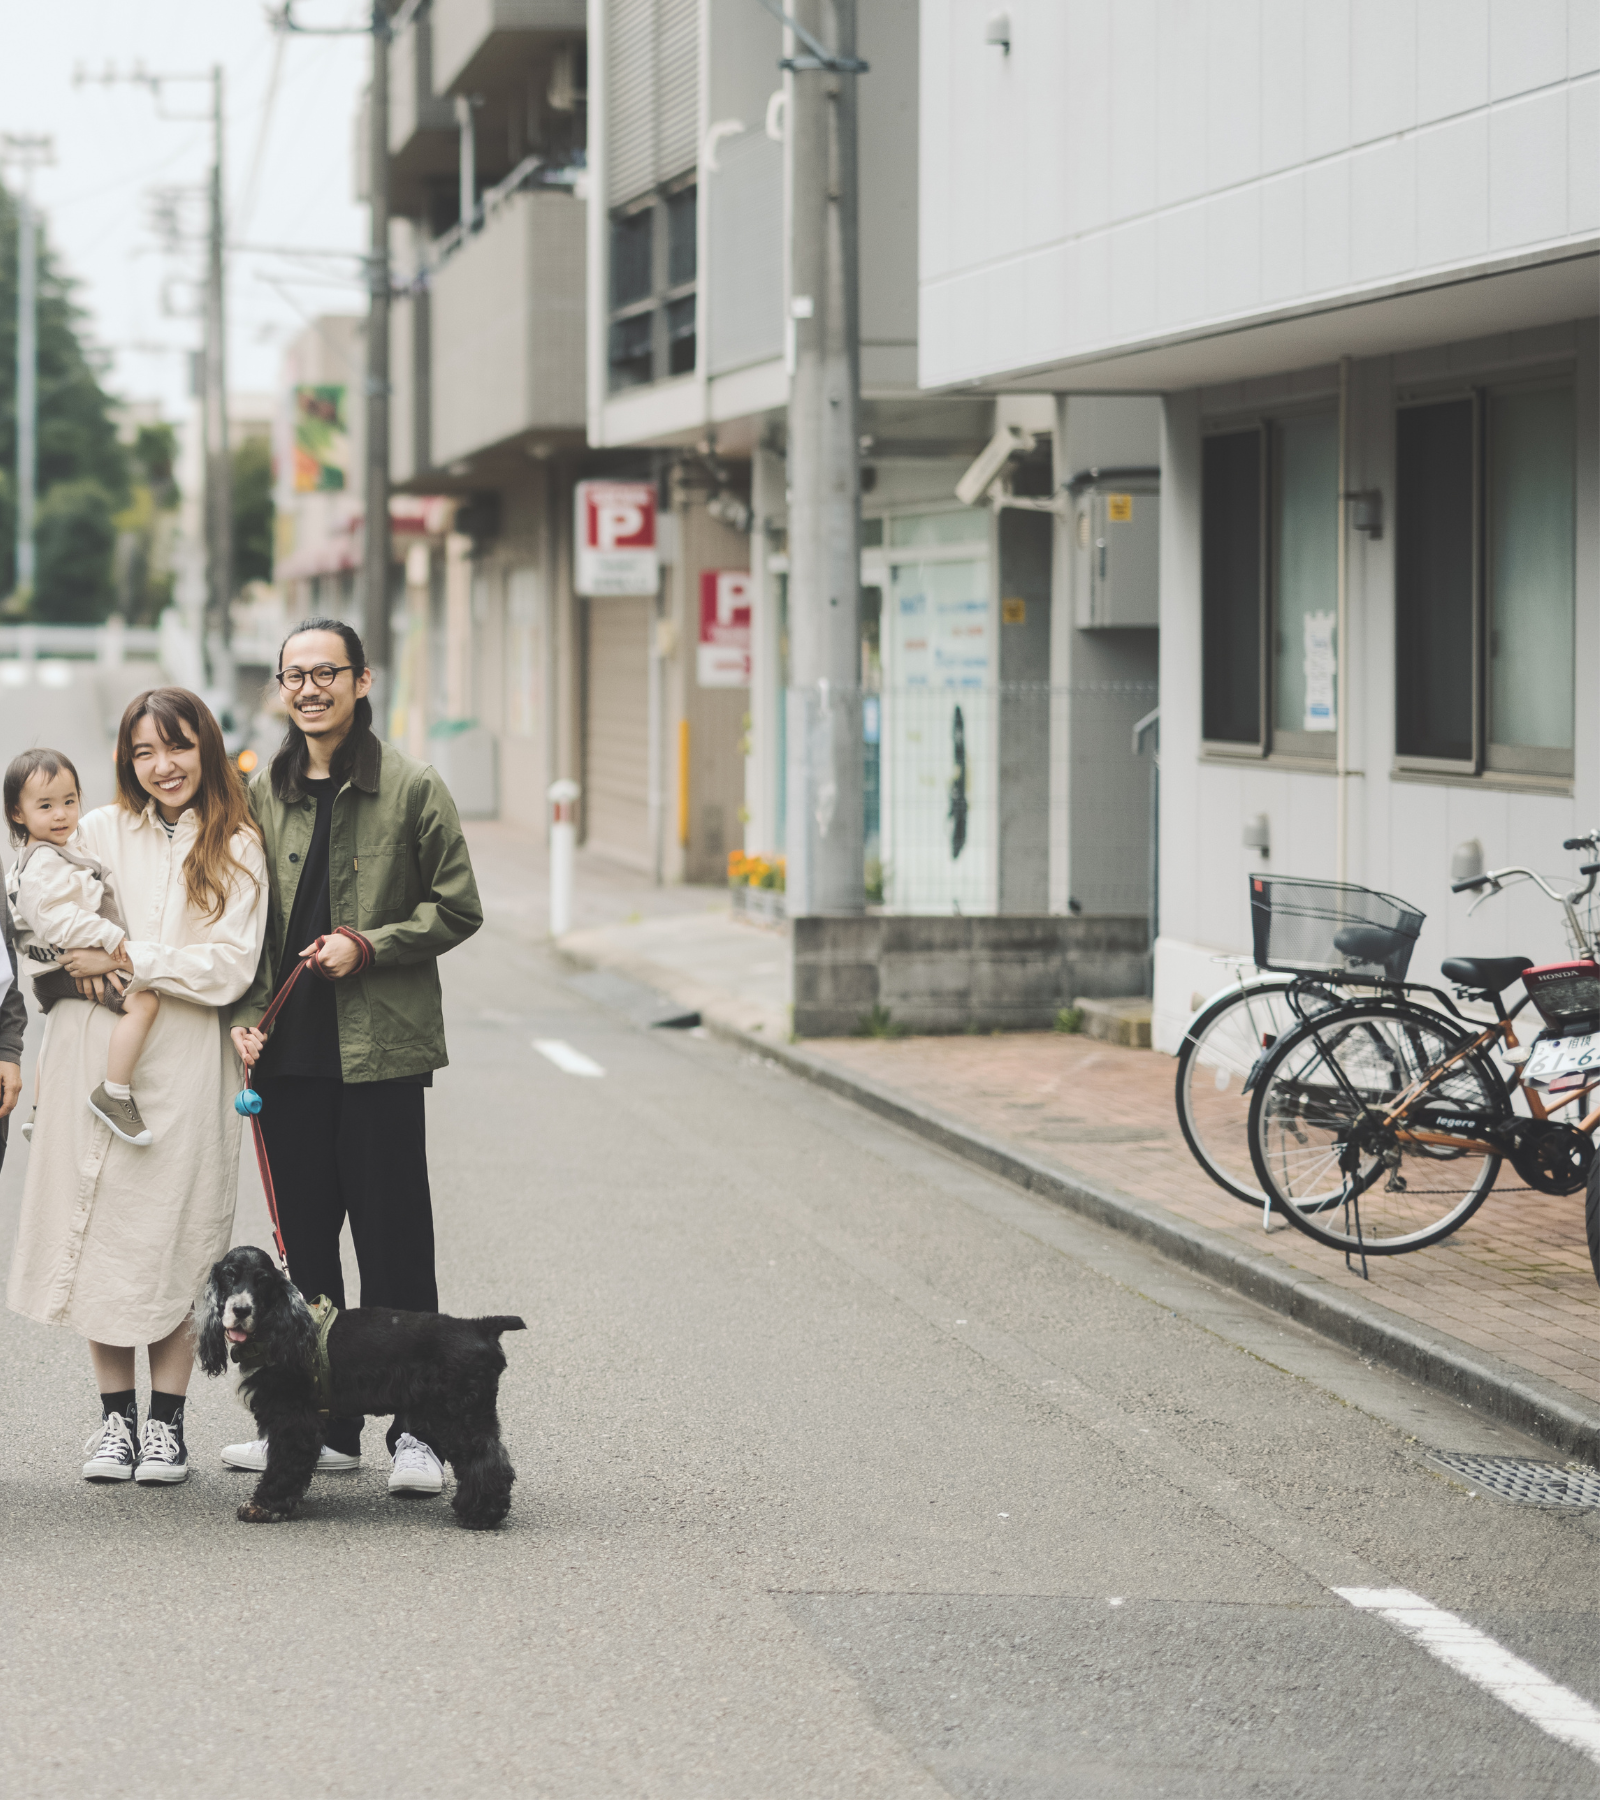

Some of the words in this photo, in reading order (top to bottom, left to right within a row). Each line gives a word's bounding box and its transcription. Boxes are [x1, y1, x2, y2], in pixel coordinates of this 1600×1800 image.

[599, 504, 645, 550] P
[1537, 970, 1580, 981] HONDA
[1529, 1047, 1600, 1074] 61-6
[1436, 1116, 1476, 1128] legere
